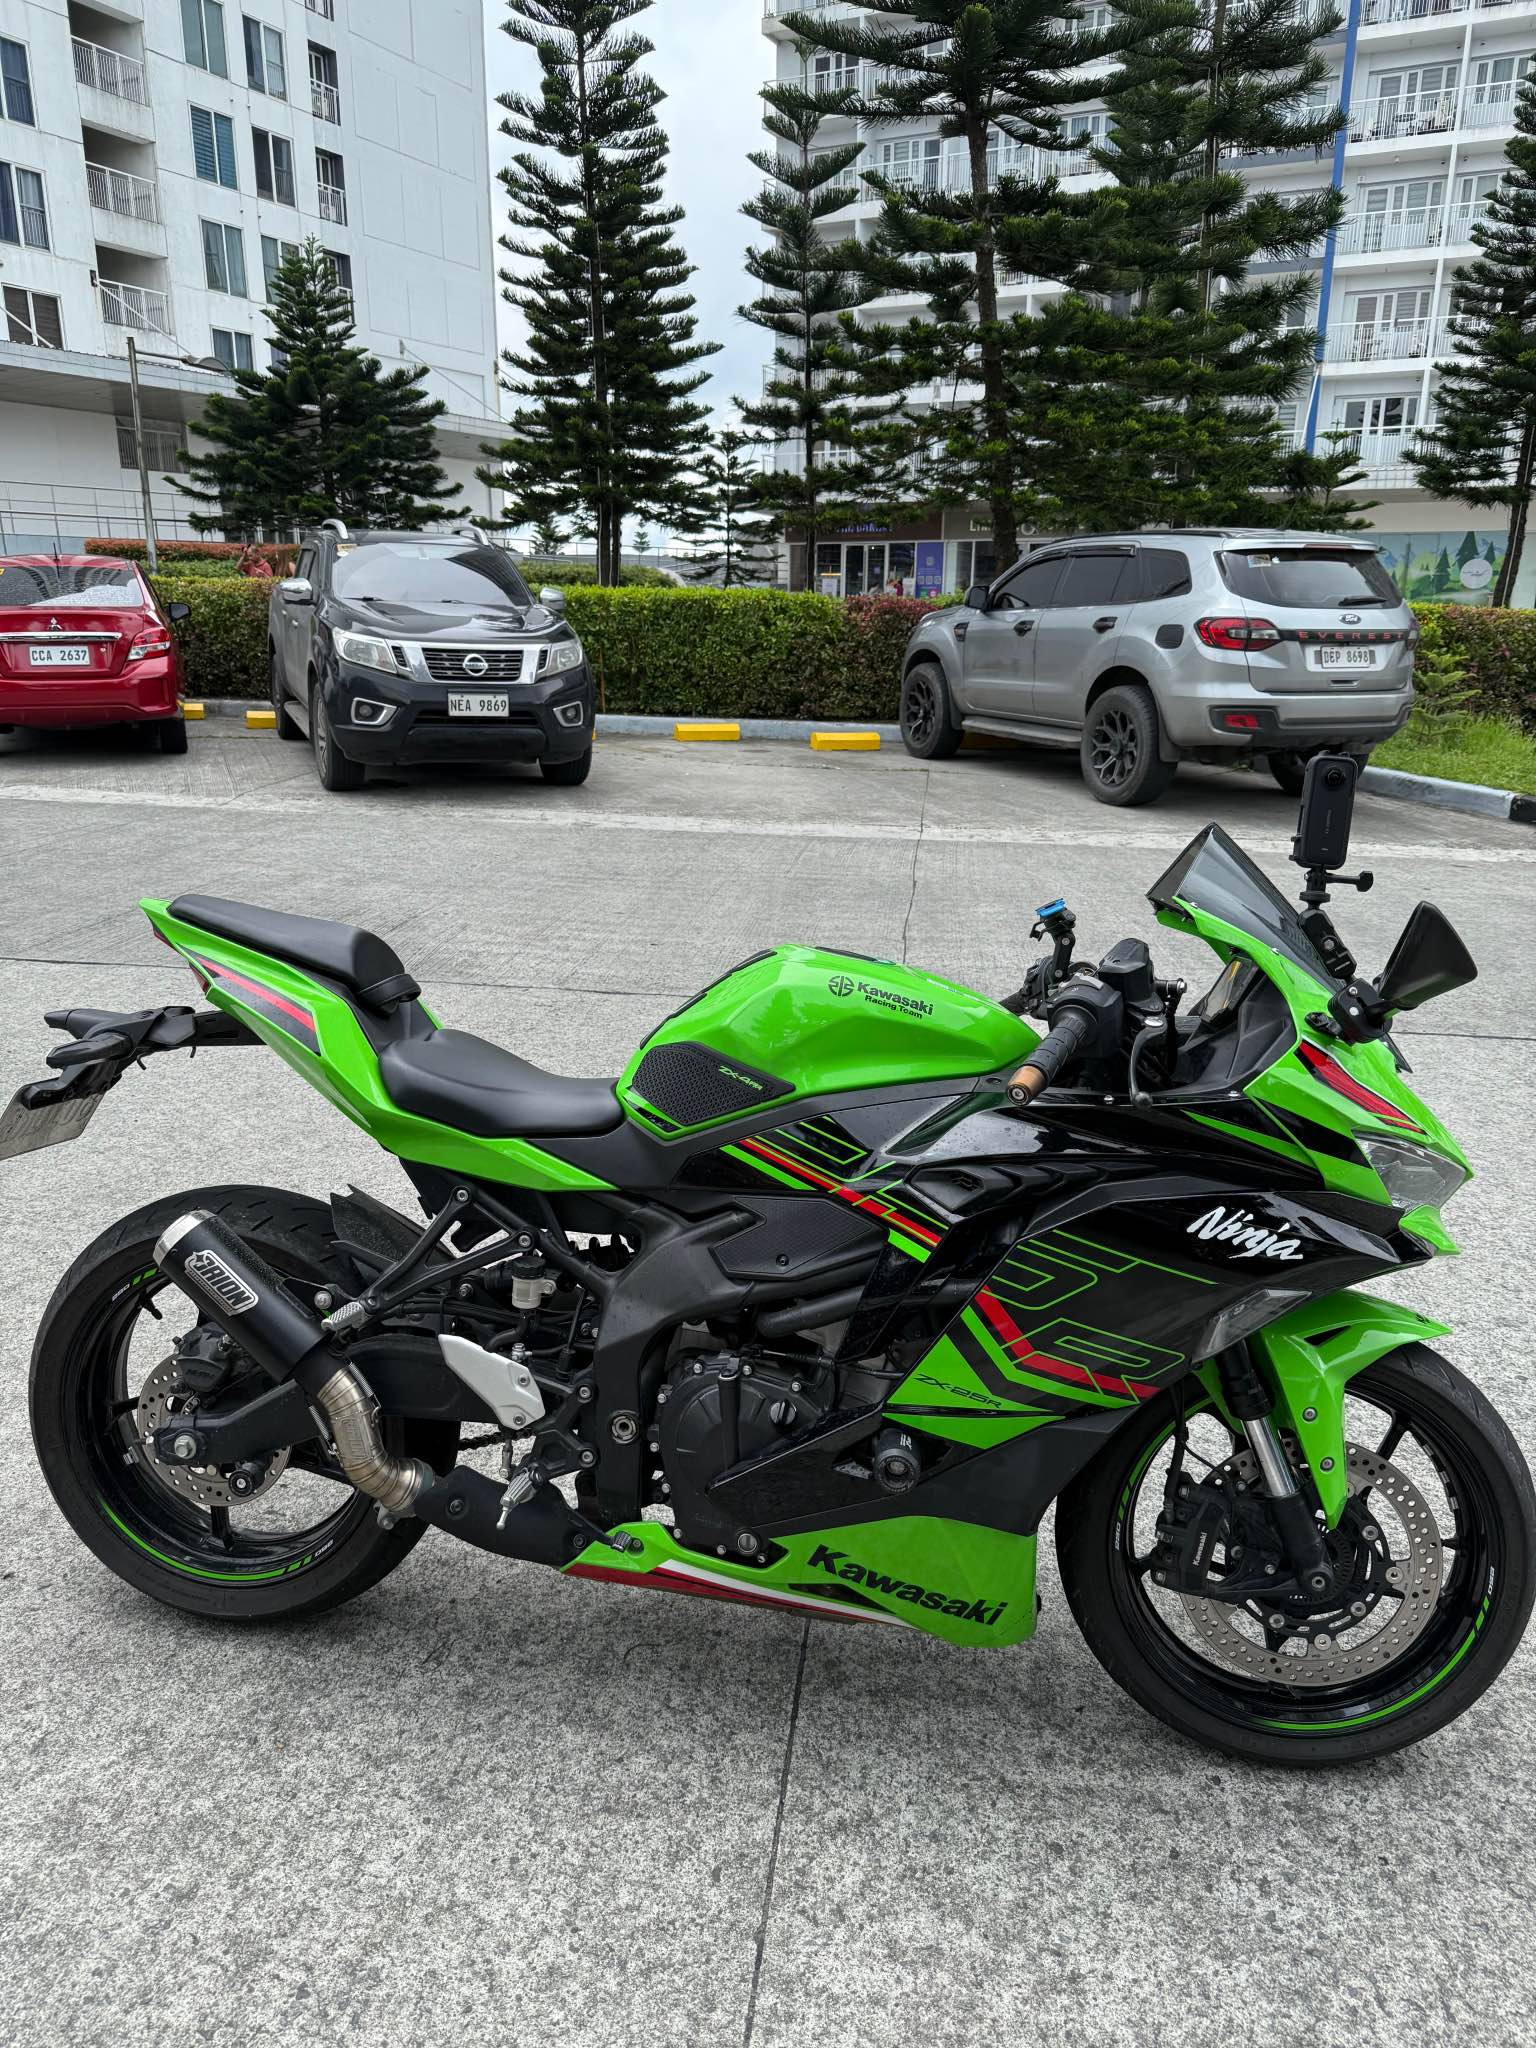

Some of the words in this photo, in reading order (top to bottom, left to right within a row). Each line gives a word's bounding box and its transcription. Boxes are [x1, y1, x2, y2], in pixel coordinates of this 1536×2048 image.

[1298, 631, 1404, 639] EVEREST
[31, 650, 53, 661] CCA
[60, 650, 87, 661] 2637
[1346, 651, 1369, 663] 8698
[450, 699, 472, 712] NEA
[479, 699, 507, 712] 9869
[857, 981, 934, 1015] Kawasaki
[864, 994, 897, 1011] Racing
[899, 1004, 923, 1019] Team
[1186, 1206, 1304, 1260] Ninja
[913, 1373, 1003, 1409] ZX-25R
[1192, 1532, 1207, 1567] Kawasaki
[807, 1544, 1009, 1625] Kawasaki
